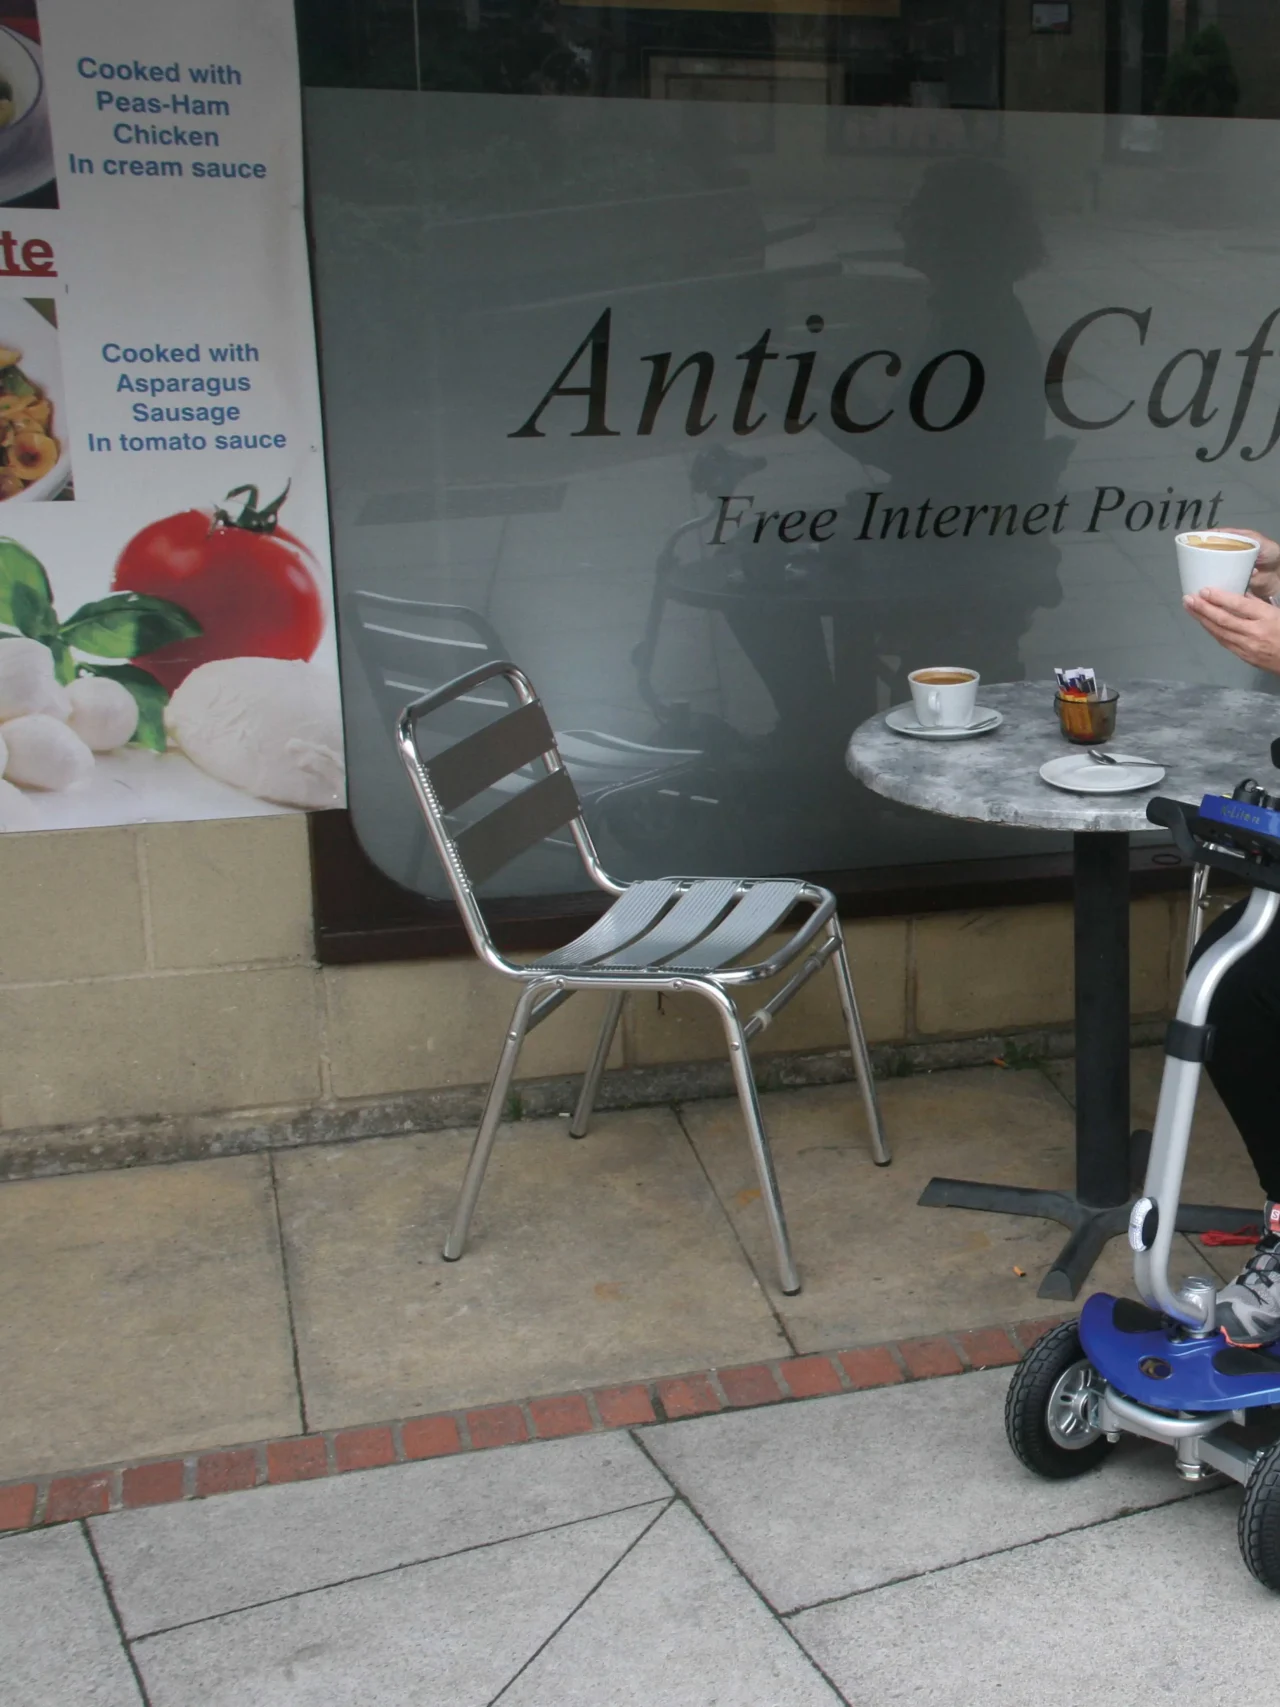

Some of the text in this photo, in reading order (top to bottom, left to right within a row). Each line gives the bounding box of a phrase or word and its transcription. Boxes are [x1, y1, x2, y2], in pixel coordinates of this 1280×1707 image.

[77, 57, 242, 86] Cooked with
[96, 91, 230, 116] Peas-Ham
[114, 124, 219, 147] Chicken
[69, 154, 267, 179] In cream sauce
[0, 230, 54, 272] te
[102, 343, 259, 363] Cooked with
[117, 374, 251, 396] Asparagus
[507, 307, 986, 438] Antico
[133, 404, 240, 425] Sausage
[89, 431, 287, 452] In tomato sauce
[706, 486, 1224, 545] Free Internet Point
